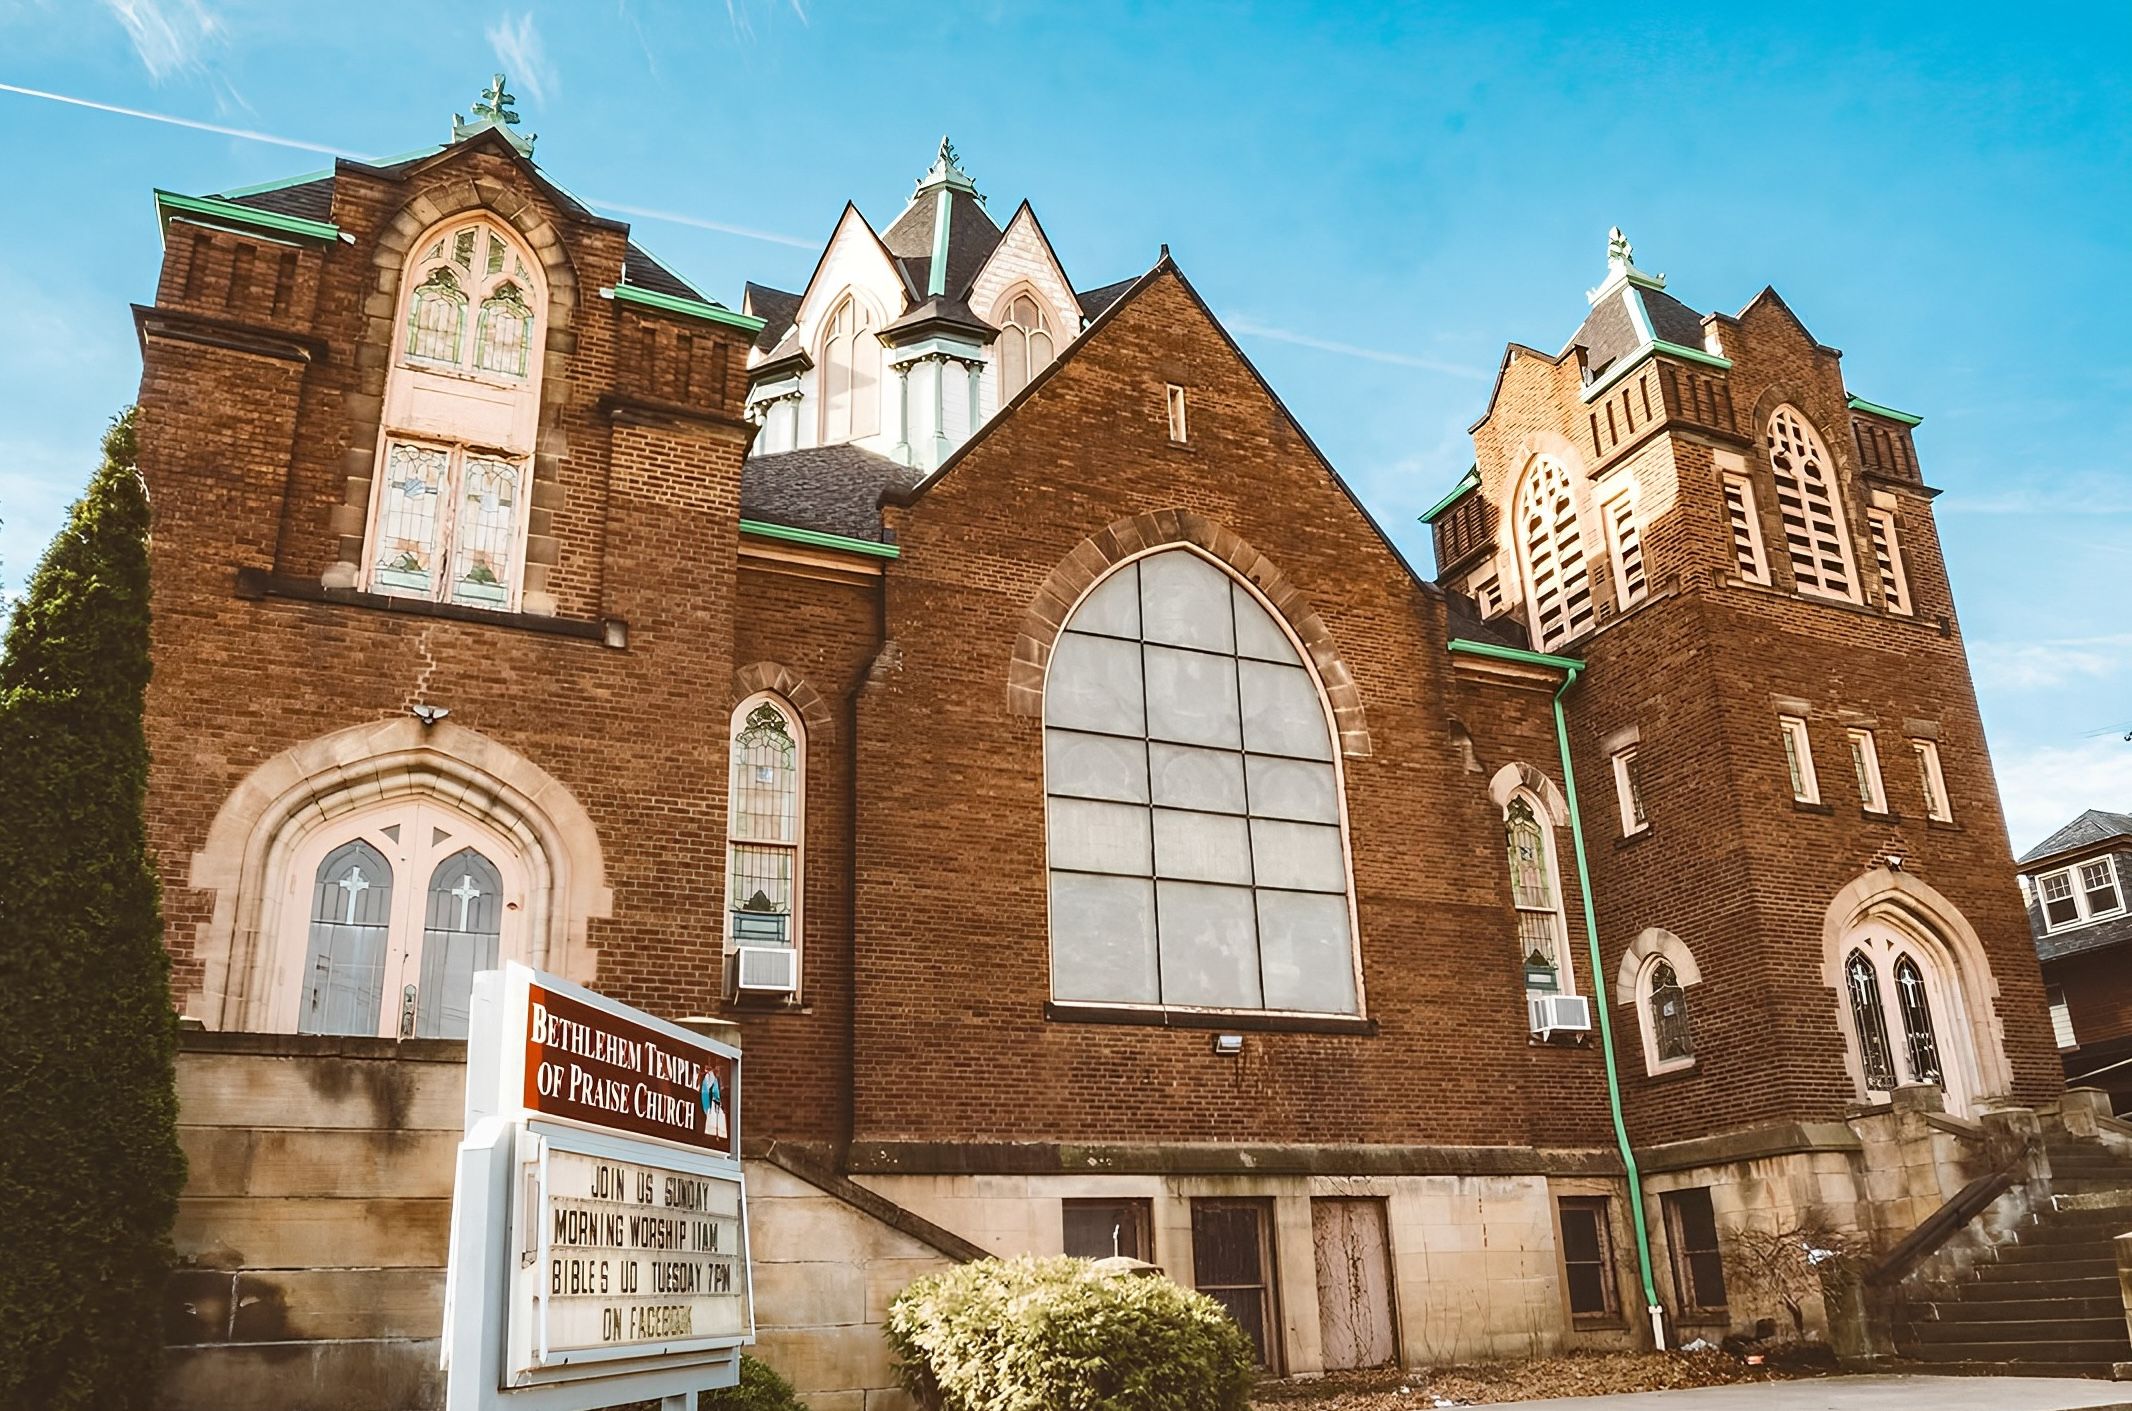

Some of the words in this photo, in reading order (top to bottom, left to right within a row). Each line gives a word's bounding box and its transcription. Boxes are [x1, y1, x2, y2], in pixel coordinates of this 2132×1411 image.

[531, 1002, 642, 1073] BETHLEHEM
[645, 1041, 701, 1093] TEMPLE
[537, 1061, 565, 1098] OF
[568, 1063, 630, 1114] PRAISE
[634, 1082, 695, 1130] CHURCH
[591, 1165, 625, 1202] JOIN
[637, 1171, 653, 1204] US
[665, 1176, 709, 1212] SUNDAY
[554, 1208, 624, 1247] MORNING
[630, 1215, 686, 1250] WORSHIP
[692, 1221, 718, 1252] 11AM
[652, 1261, 702, 1293] TUESDAY
[603, 1307, 622, 1341] ON
